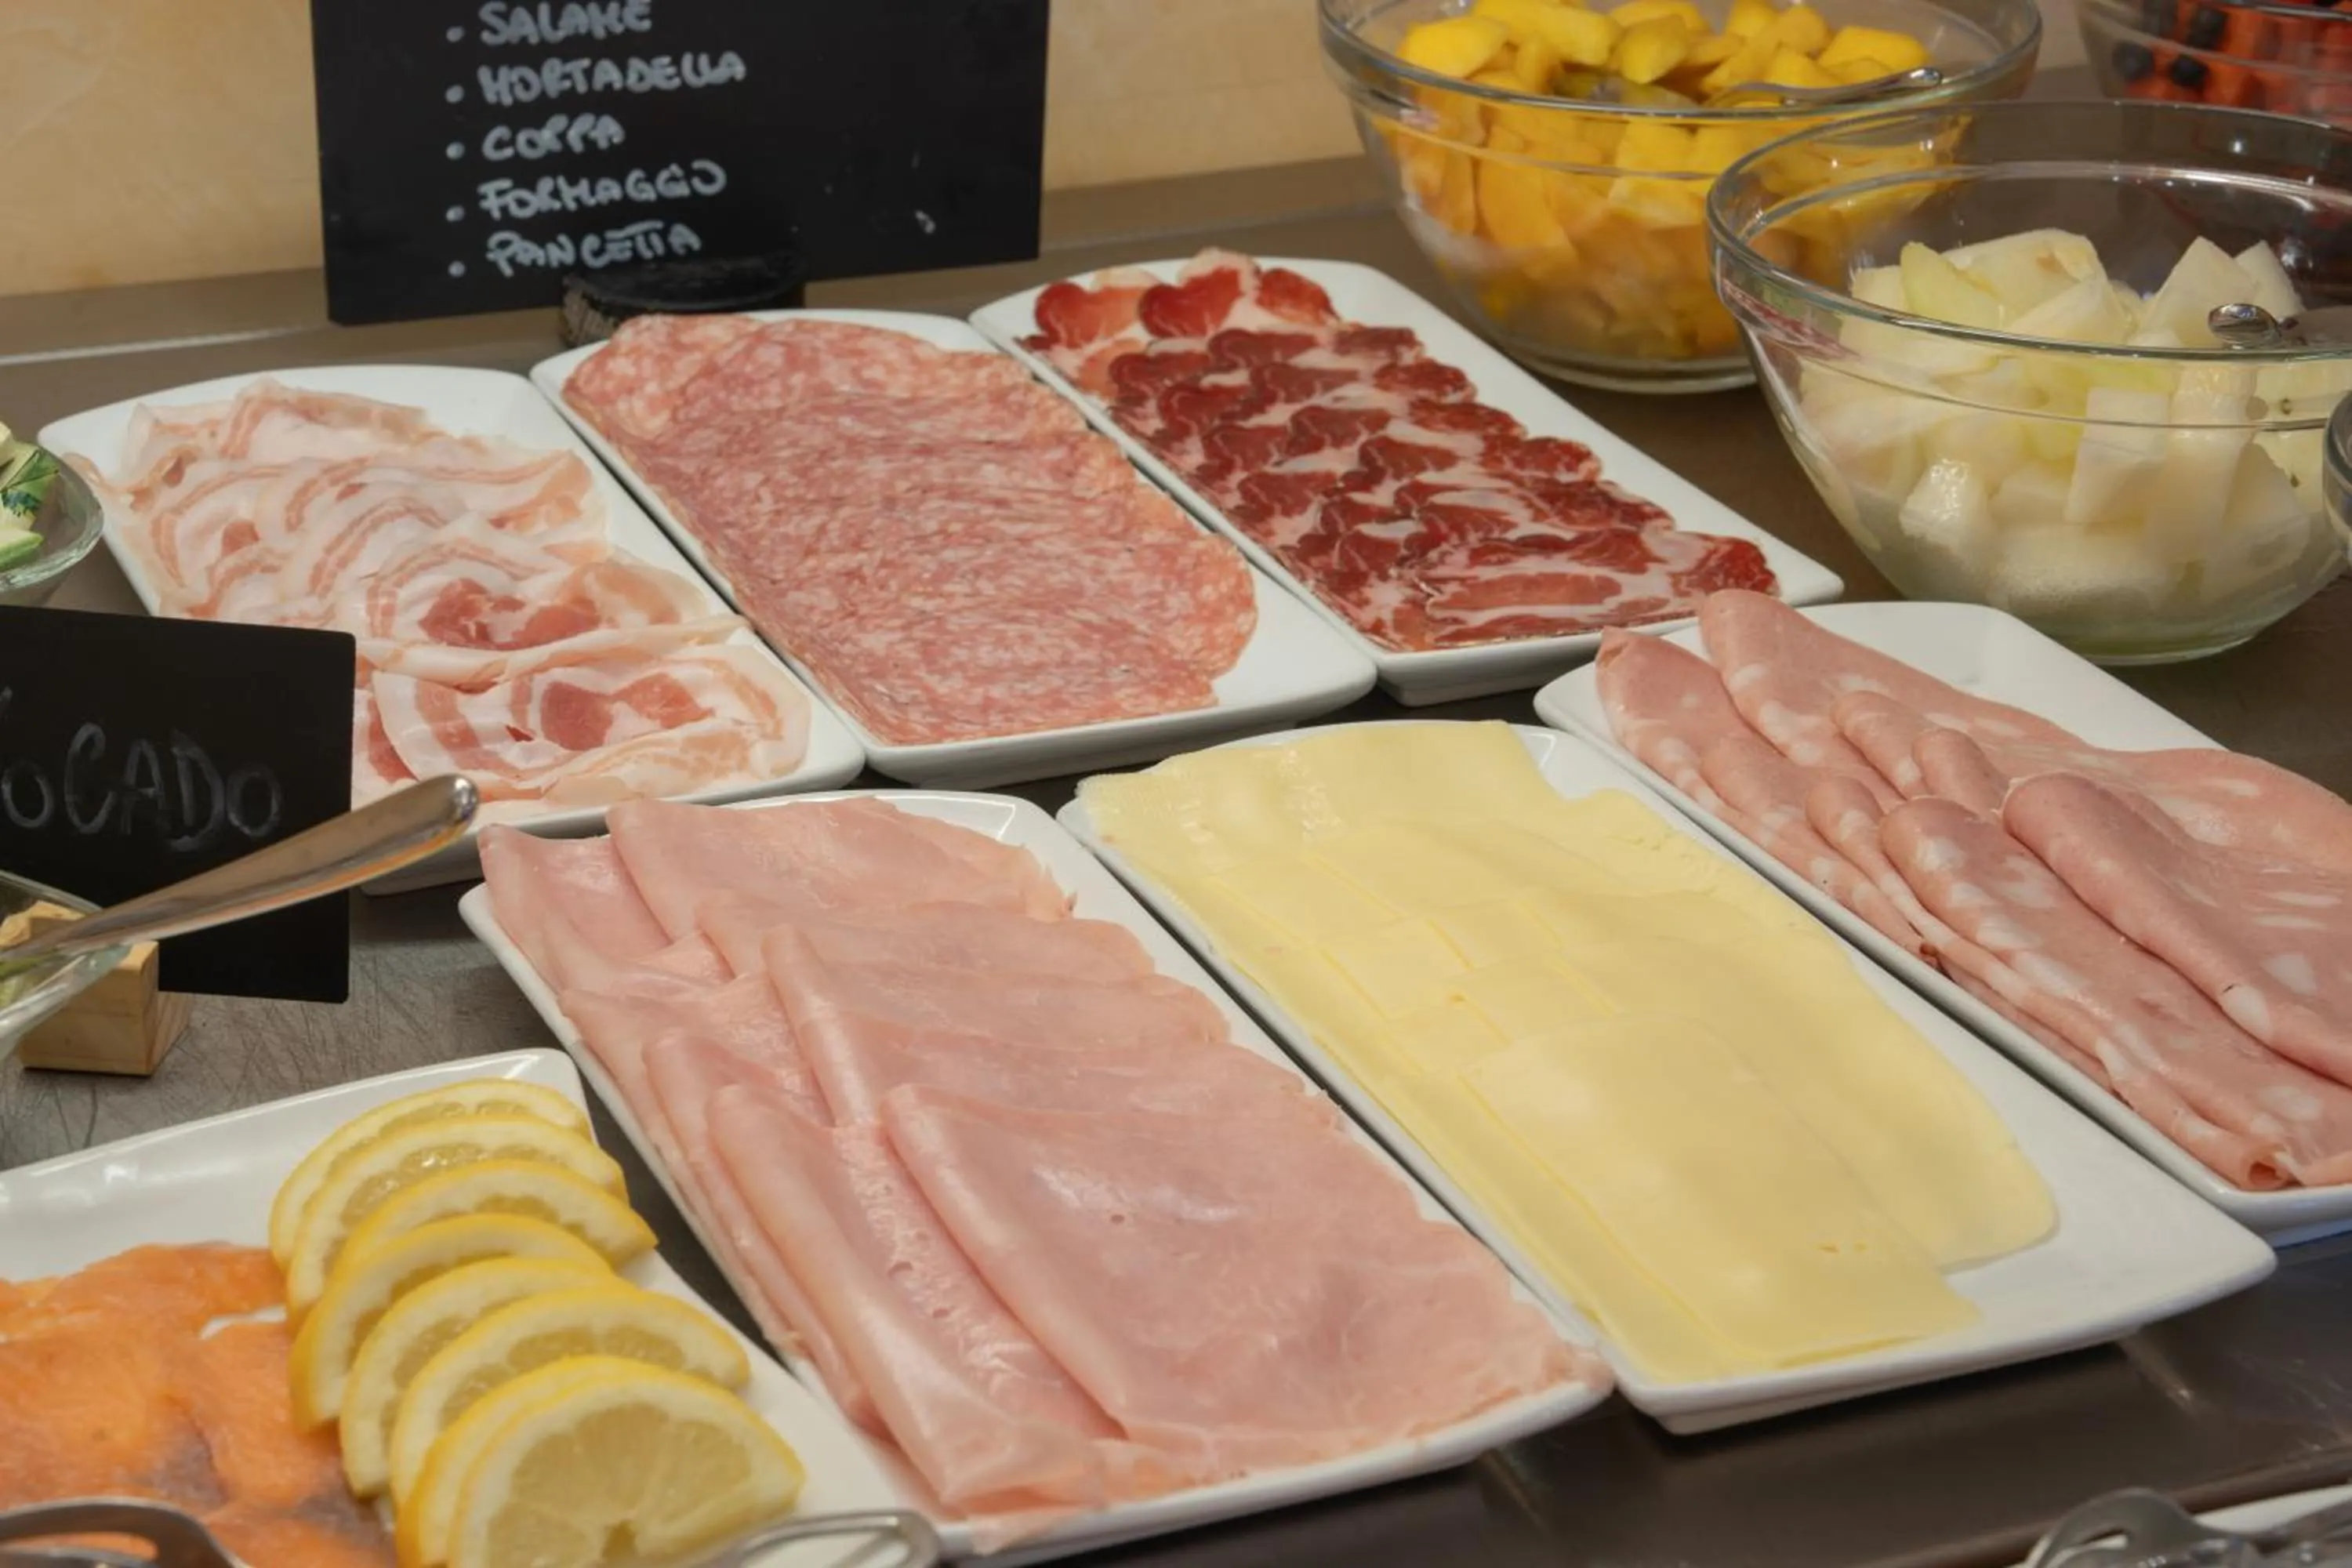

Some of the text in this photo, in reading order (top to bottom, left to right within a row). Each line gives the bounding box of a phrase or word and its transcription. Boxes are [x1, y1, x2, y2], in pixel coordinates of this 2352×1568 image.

[477, 0, 653, 45] SALAME
[481, 113, 626, 161] COPPA
[485, 220, 702, 278] PANCETTA
[0, 685, 284, 852] OCADO
